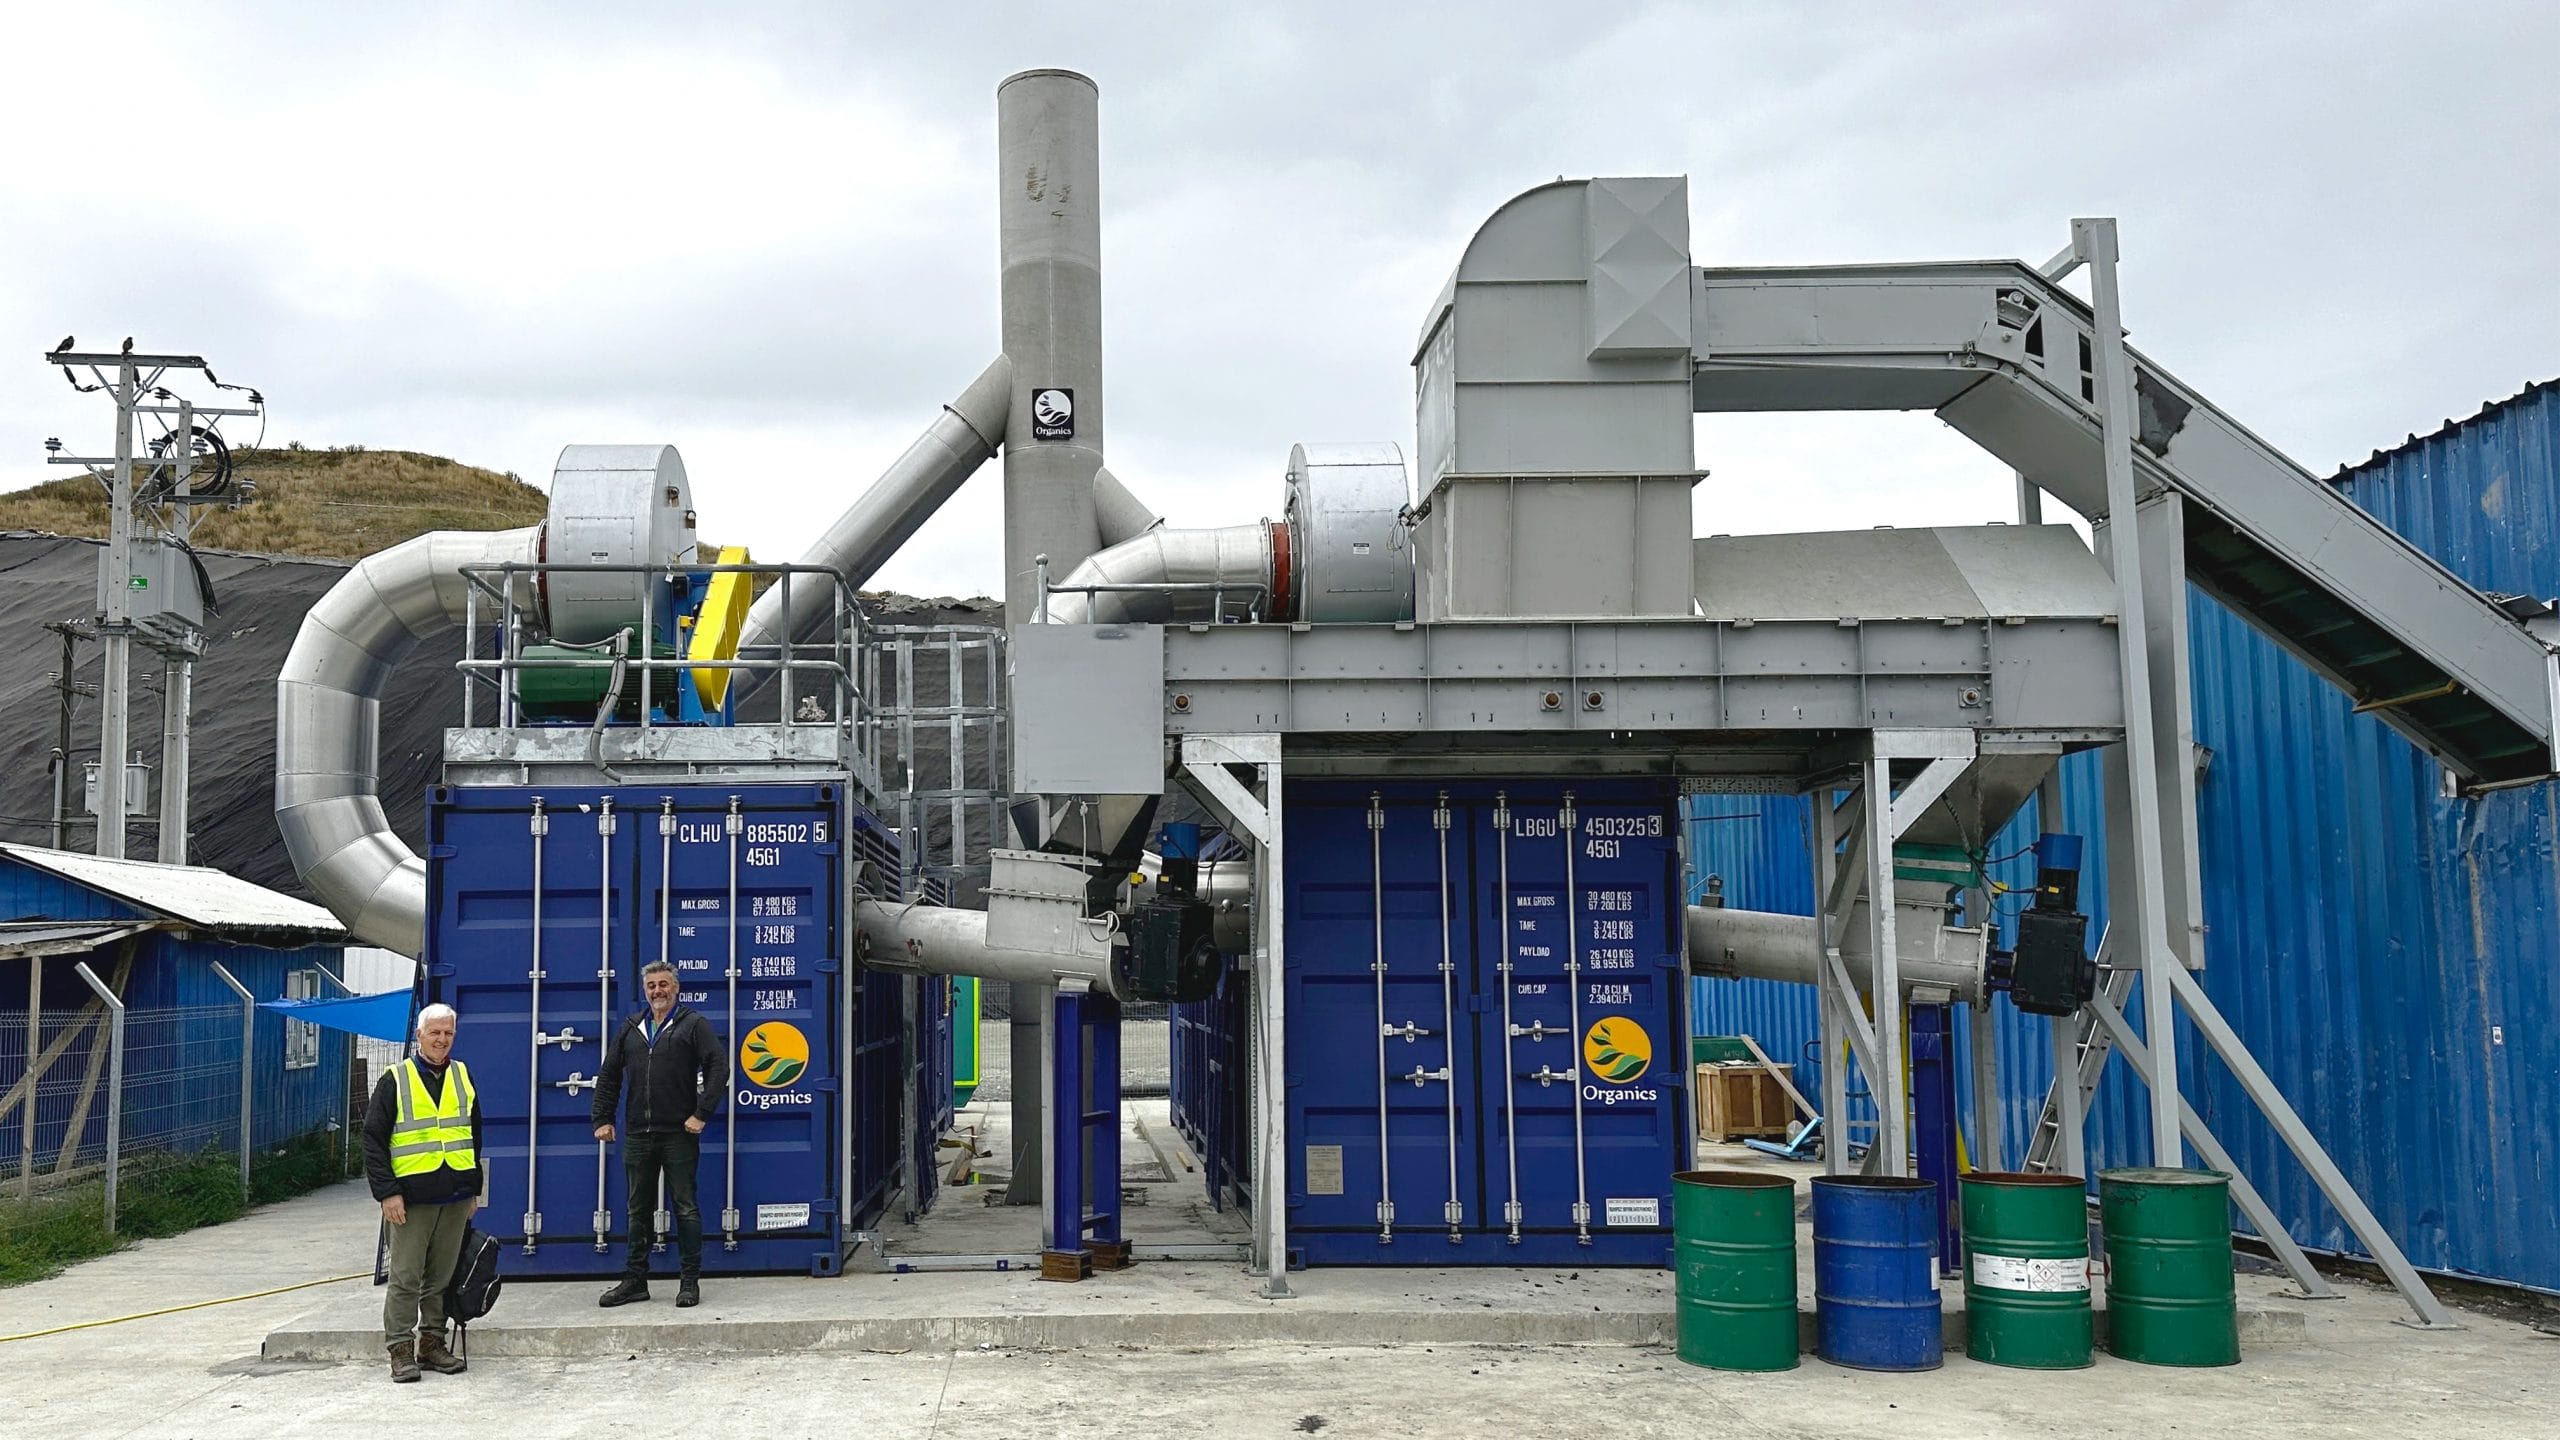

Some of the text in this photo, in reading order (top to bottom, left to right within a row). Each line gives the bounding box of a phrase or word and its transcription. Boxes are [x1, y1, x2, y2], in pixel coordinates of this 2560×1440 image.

[1035, 427, 1071, 436] Organics
[1515, 816, 1661, 837] LBGU 450325 3
[680, 822, 826, 843] CLHU 885502 5
[1586, 839, 1620, 858] 45G1
[746, 847, 780, 866] 45G1
[782, 896, 796, 906] KGS
[1617, 891, 1632, 901] KGS
[1617, 901, 1632, 910] LBS
[782, 906, 796, 916] LBS
[781, 925, 795, 935] KGS
[1519, 920, 1536, 931] TARE
[1619, 920, 1633, 930] KGS
[678, 926, 695, 937] TARE
[1619, 929, 1634, 939] LBS
[780, 934, 795, 944] LBS
[1519, 946, 1550, 956] PAYLOAD
[1619, 949, 1634, 959] KGS
[678, 959, 708, 970] PAYLOAD
[781, 956, 796, 966] KGS
[1619, 958, 1634, 968] LBS
[781, 966, 796, 976] LBS
[738, 1090, 812, 1110] Organics
[1583, 1085, 1657, 1105] Organics
